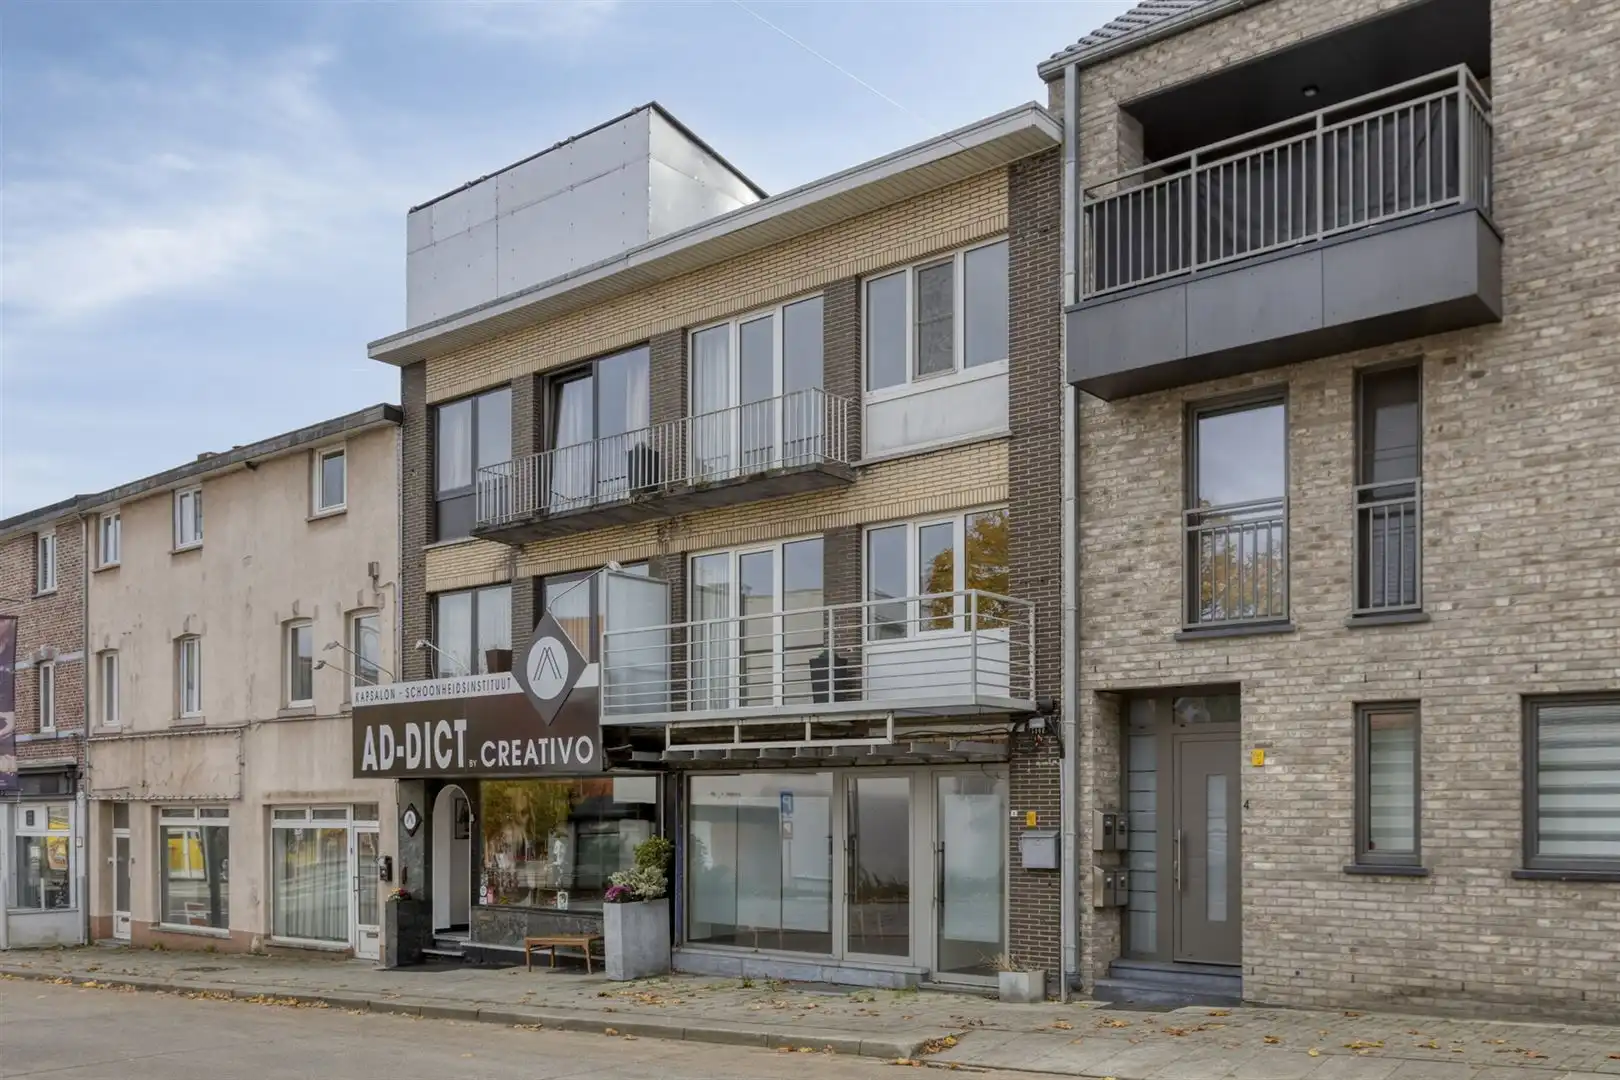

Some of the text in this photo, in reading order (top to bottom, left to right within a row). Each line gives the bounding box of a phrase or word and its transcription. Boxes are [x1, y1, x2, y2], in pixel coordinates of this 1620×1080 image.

[355, 688, 396, 703] KAPSALON
[405, 677, 511, 699] SCHOONHEIDSINSTITUUT
[361, 719, 594, 771] AD-DICT BY CREATIVO
